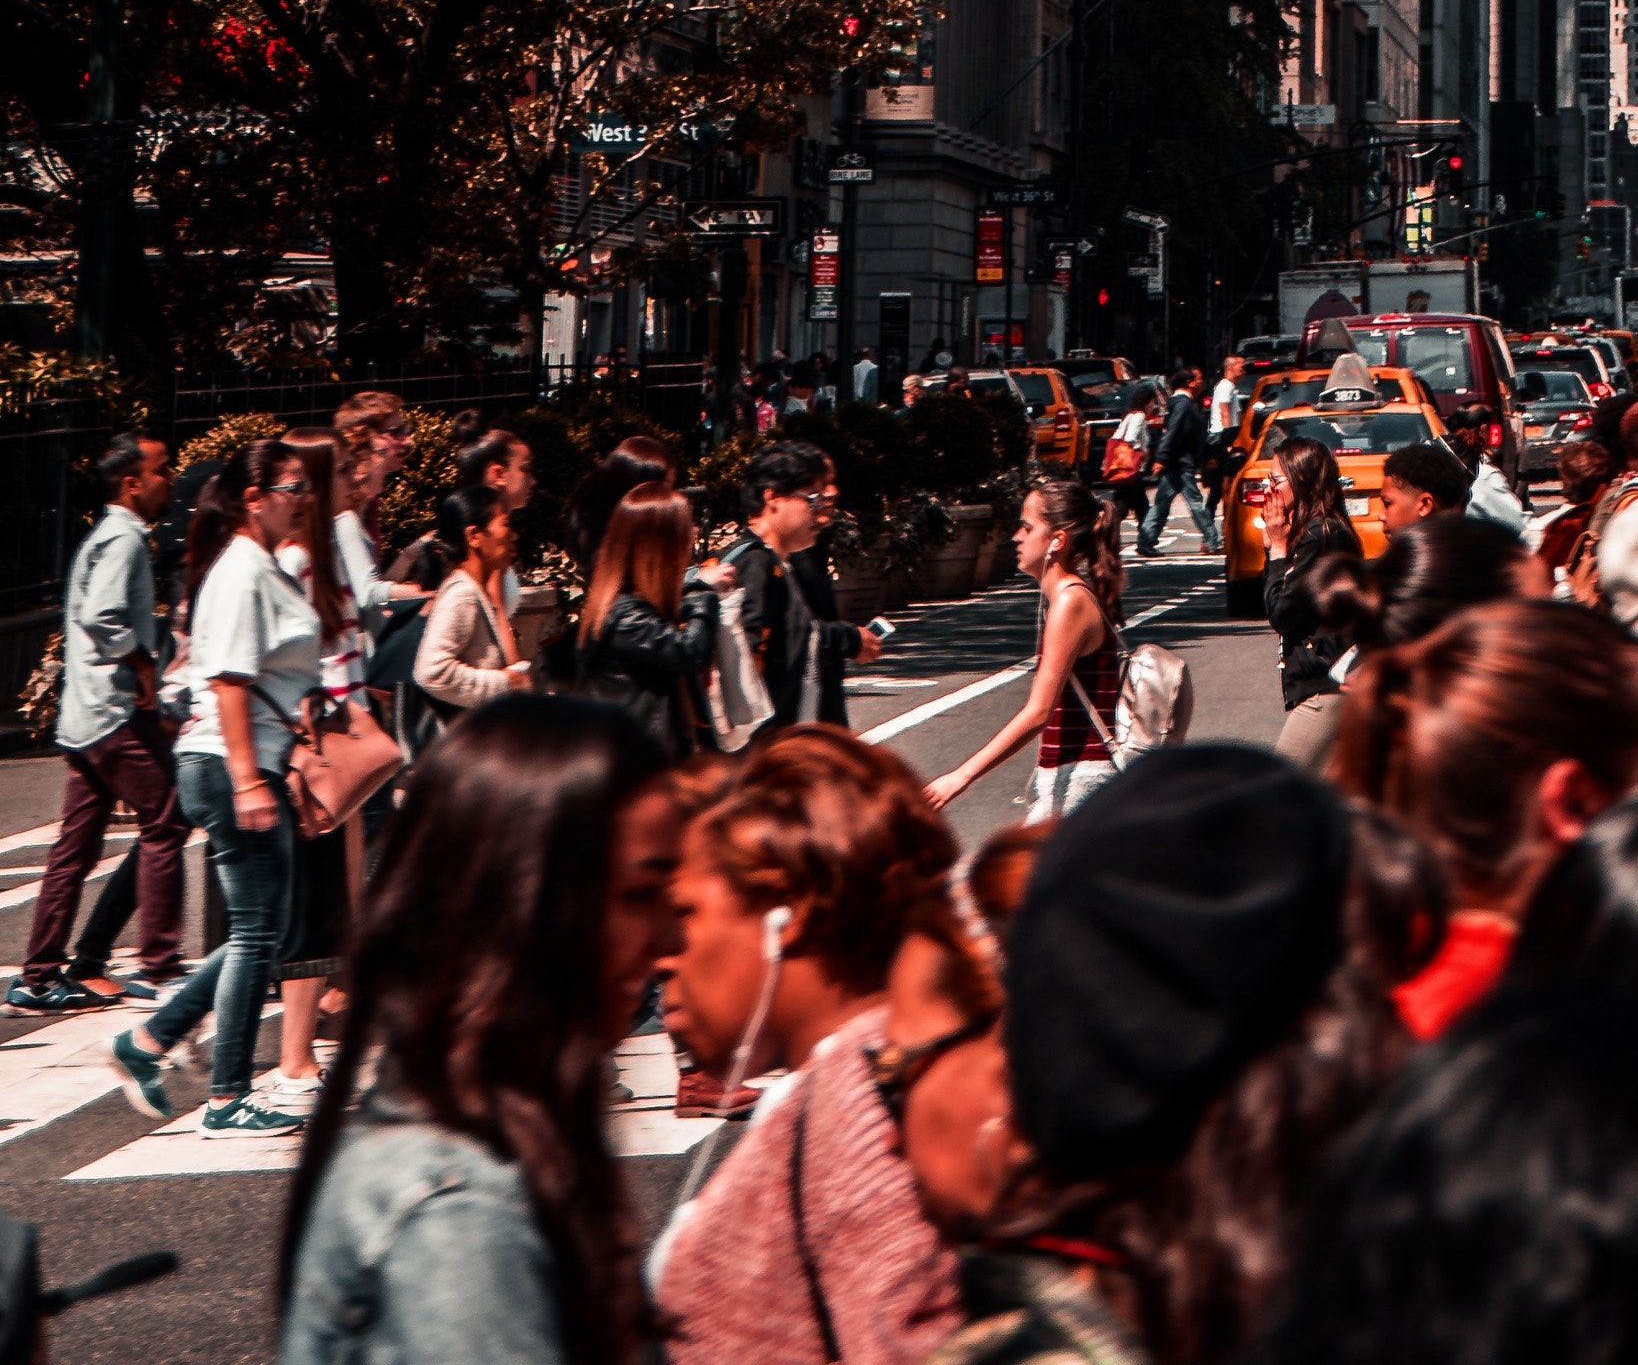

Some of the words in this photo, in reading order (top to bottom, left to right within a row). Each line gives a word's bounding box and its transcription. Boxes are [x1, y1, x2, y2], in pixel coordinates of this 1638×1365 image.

[587, 122, 632, 143] West
[829, 170, 849, 179] BIKE
[851, 170, 872, 179] LANE
[1044, 190, 1054, 202] St
